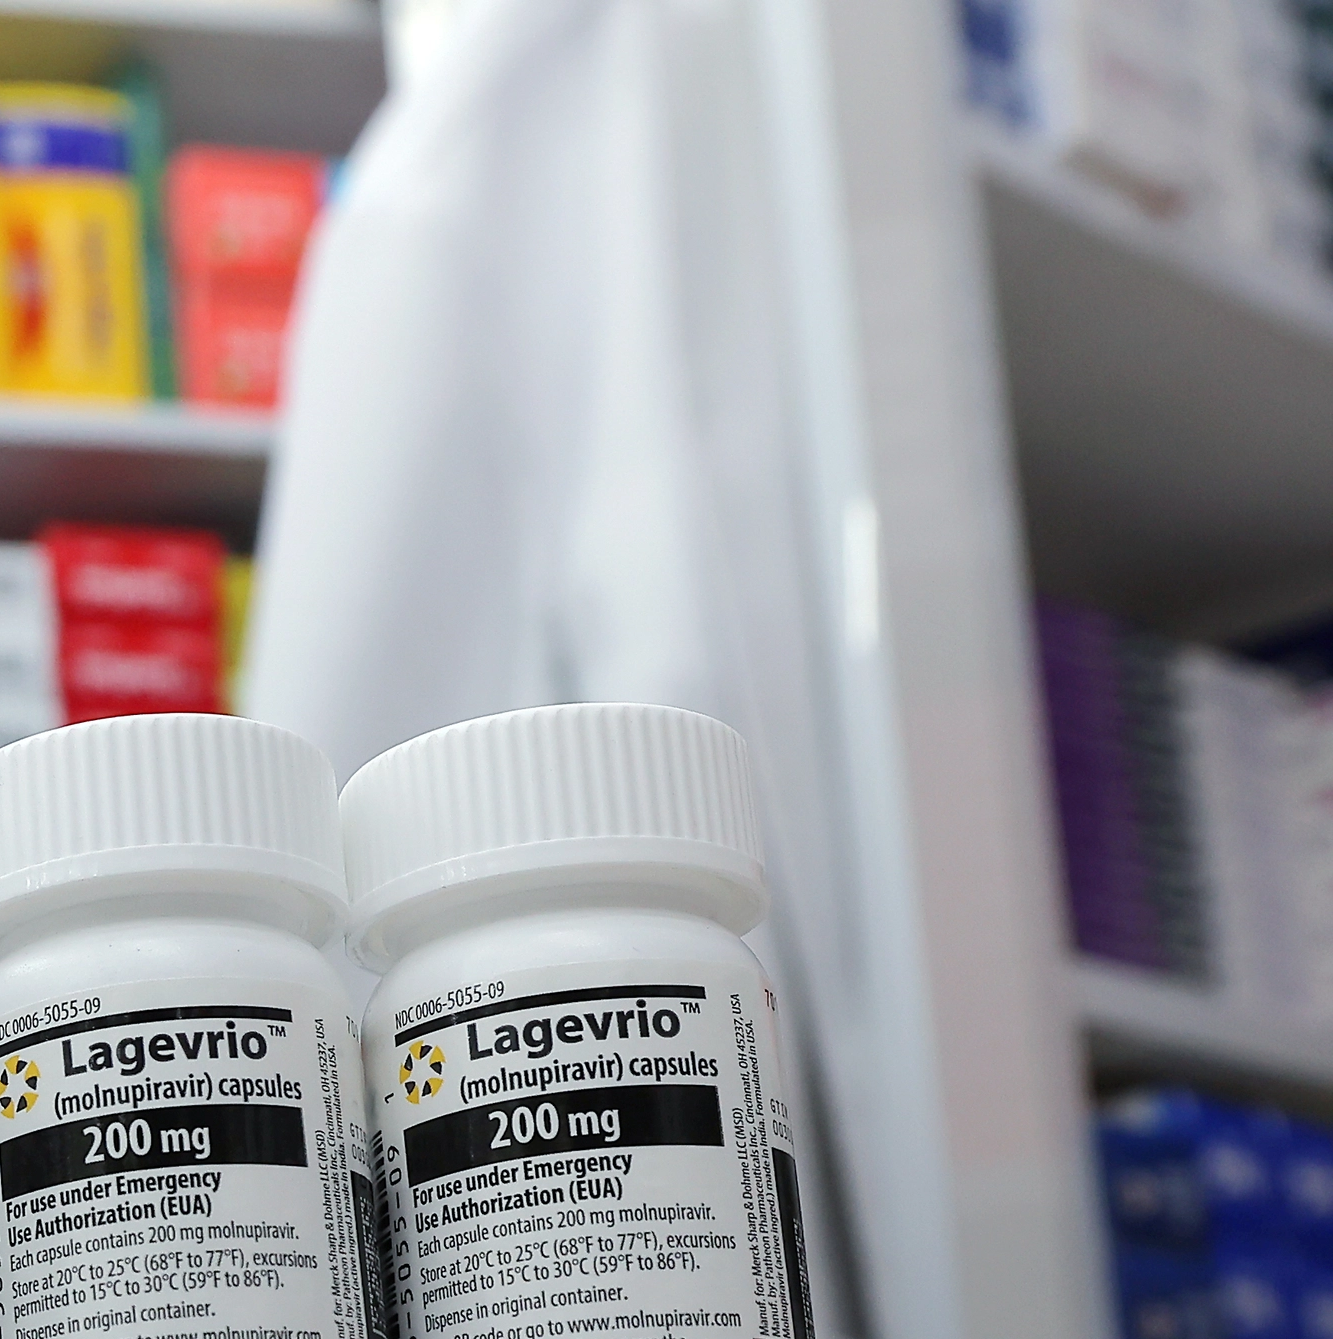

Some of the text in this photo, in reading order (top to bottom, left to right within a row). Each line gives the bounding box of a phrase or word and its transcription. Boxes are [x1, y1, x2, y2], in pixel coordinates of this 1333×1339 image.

[13, 997, 101, 1034] 0006-5055-09
[395, 981, 505, 1030] NDC 0006-5055-09
[54, 1072, 302, 1120] (molnupiravir) capsules
[459, 1053, 718, 1104] (molnupiravir) capsules
[83, 1119, 210, 1165] 200 mg
[489, 1102, 620, 1150] 200 mg
[6, 1169, 221, 1222] For use under Emergency
[413, 1153, 633, 1208] For use under Emergency
[415, 1177, 623, 1233] Use Authorization (EUA)
[8, 1194, 212, 1246] Use Authorization (EUA)
[418, 1201, 715, 1258] Each capsule contains 200 mg molnupiravir.
[420, 1231, 736, 1285] Store at 20°C to 25°C (68°F to 77°F), excursions
[422, 1251, 700, 1307] permitted to 15°C to 30°C (59°F to 86°F).
